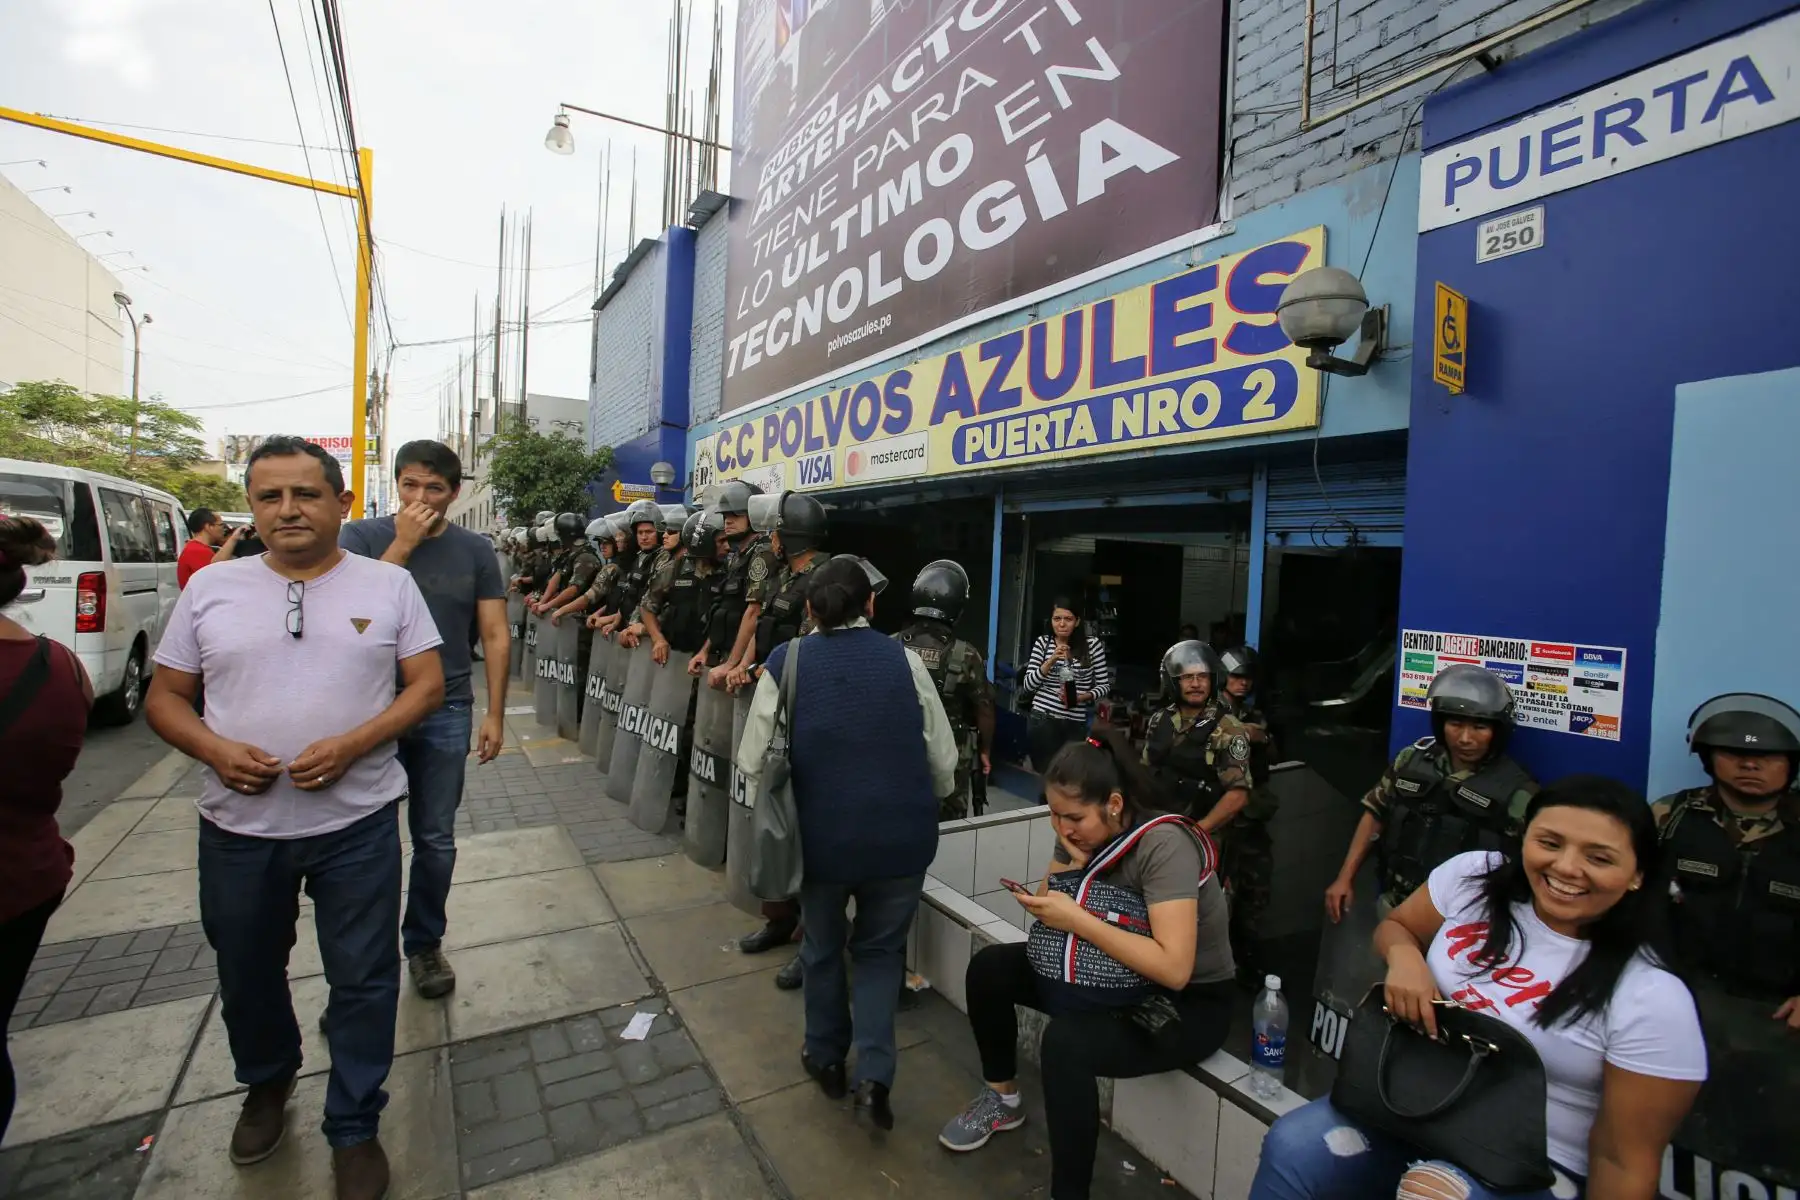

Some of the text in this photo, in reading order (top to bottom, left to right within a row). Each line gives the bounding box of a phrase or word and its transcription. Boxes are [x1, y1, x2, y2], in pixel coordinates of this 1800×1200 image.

[762, 103, 833, 184] RUBRO
[1445, 55, 1776, 207] PUERTA
[736, 36, 1121, 320] LO ÚLTIMO EN
[753, 173, 839, 267] TIENE
[852, 67, 998, 190] PARA
[726, 118, 1181, 379] TECNOLOGÍA
[1486, 226, 1534, 256] 250
[762, 370, 913, 462] POLVOS
[929, 241, 1311, 427] AZULES
[827, 313, 892, 357] polvosazules.pe
[1439, 362, 1462, 381] RAMPA
[964, 368, 1276, 462] PUERTA NRO 2
[797, 454, 832, 485] VISA
[870, 443, 925, 465] mastercard
[1403, 632, 1434, 652] CENTRO
[1444, 635, 1478, 656] AGENTE
[1479, 639, 1528, 660] BANCARIO:
[1583, 653, 1603, 661] BBVA
[1526, 698, 1554, 707] PASAJE
[1532, 714, 1558, 726] entel
